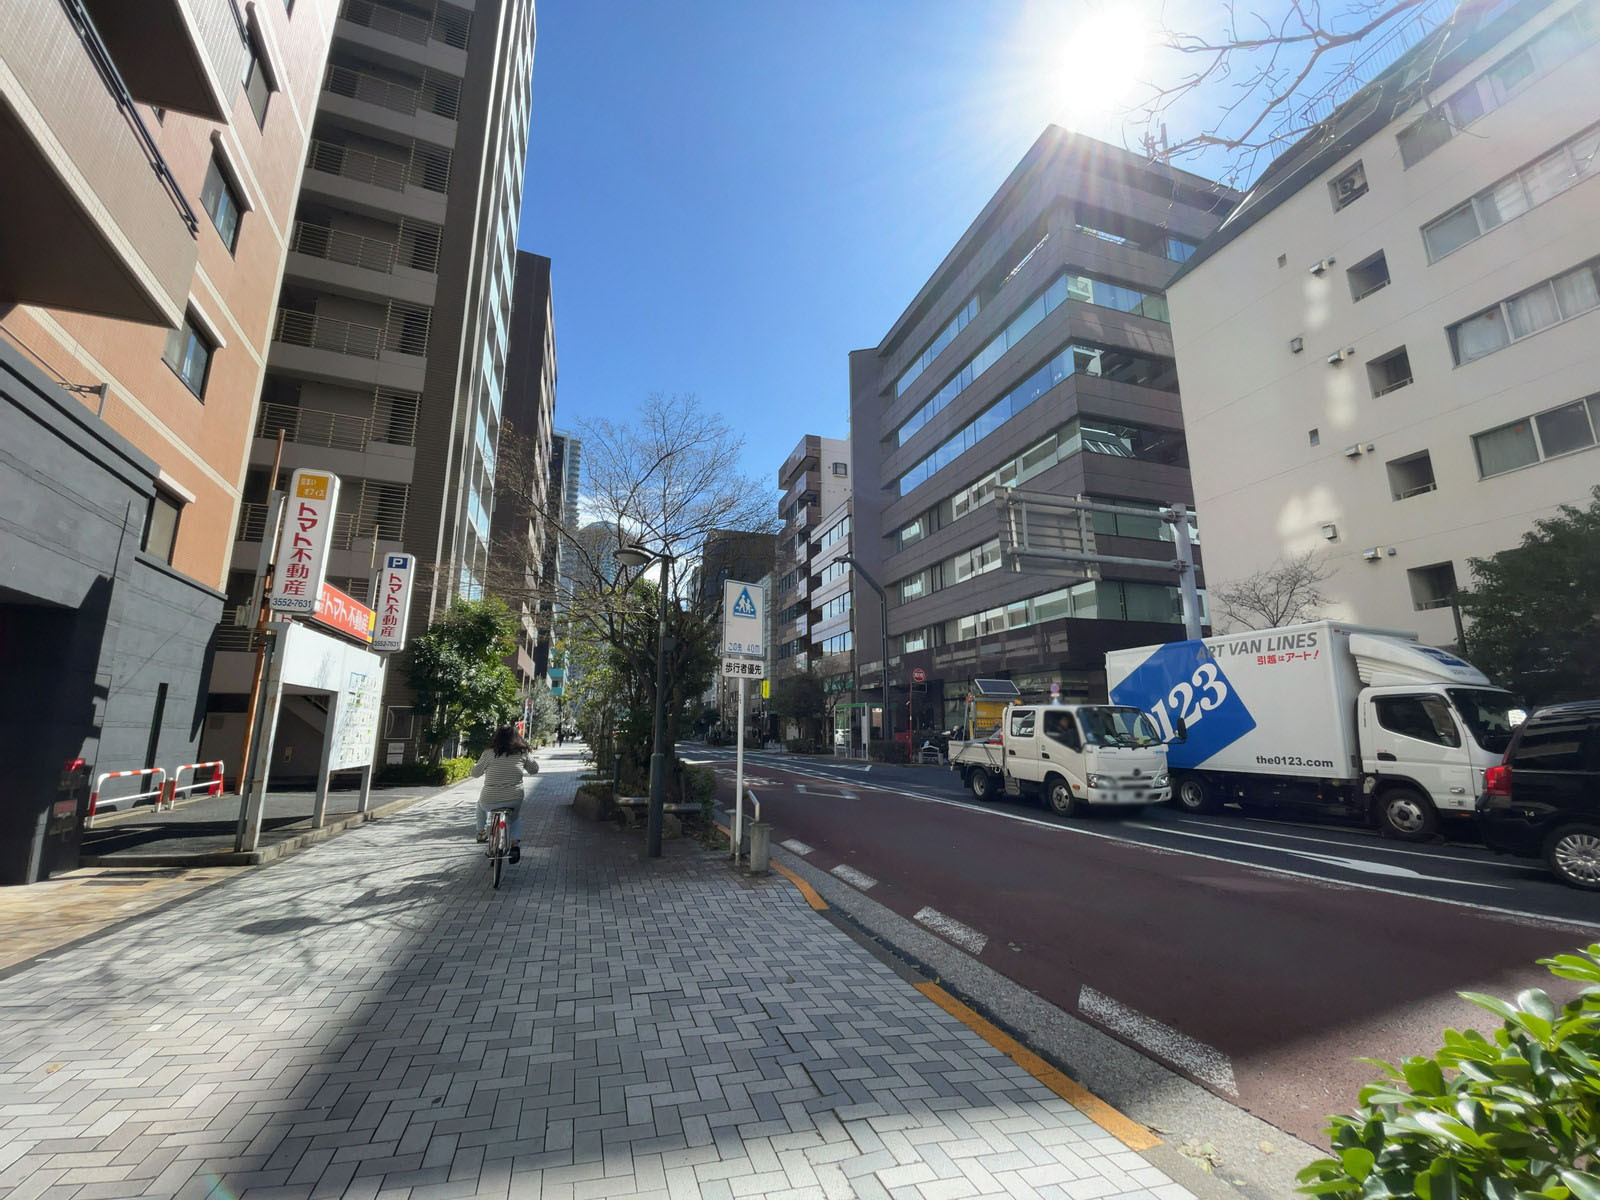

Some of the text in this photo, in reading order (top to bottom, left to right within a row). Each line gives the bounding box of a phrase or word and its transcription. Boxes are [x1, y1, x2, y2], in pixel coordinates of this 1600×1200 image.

[283, 502, 318, 596] トマト不動産
[392, 558, 403, 568] P
[271, 597, 312, 608] 3552-7631
[380, 573, 402, 637] トマト不動産
[1196, 632, 1318, 660] ART VAN LINES
[725, 662, 762, 675] 歩行者優先
[1256, 755, 1334, 768] the0123.com
